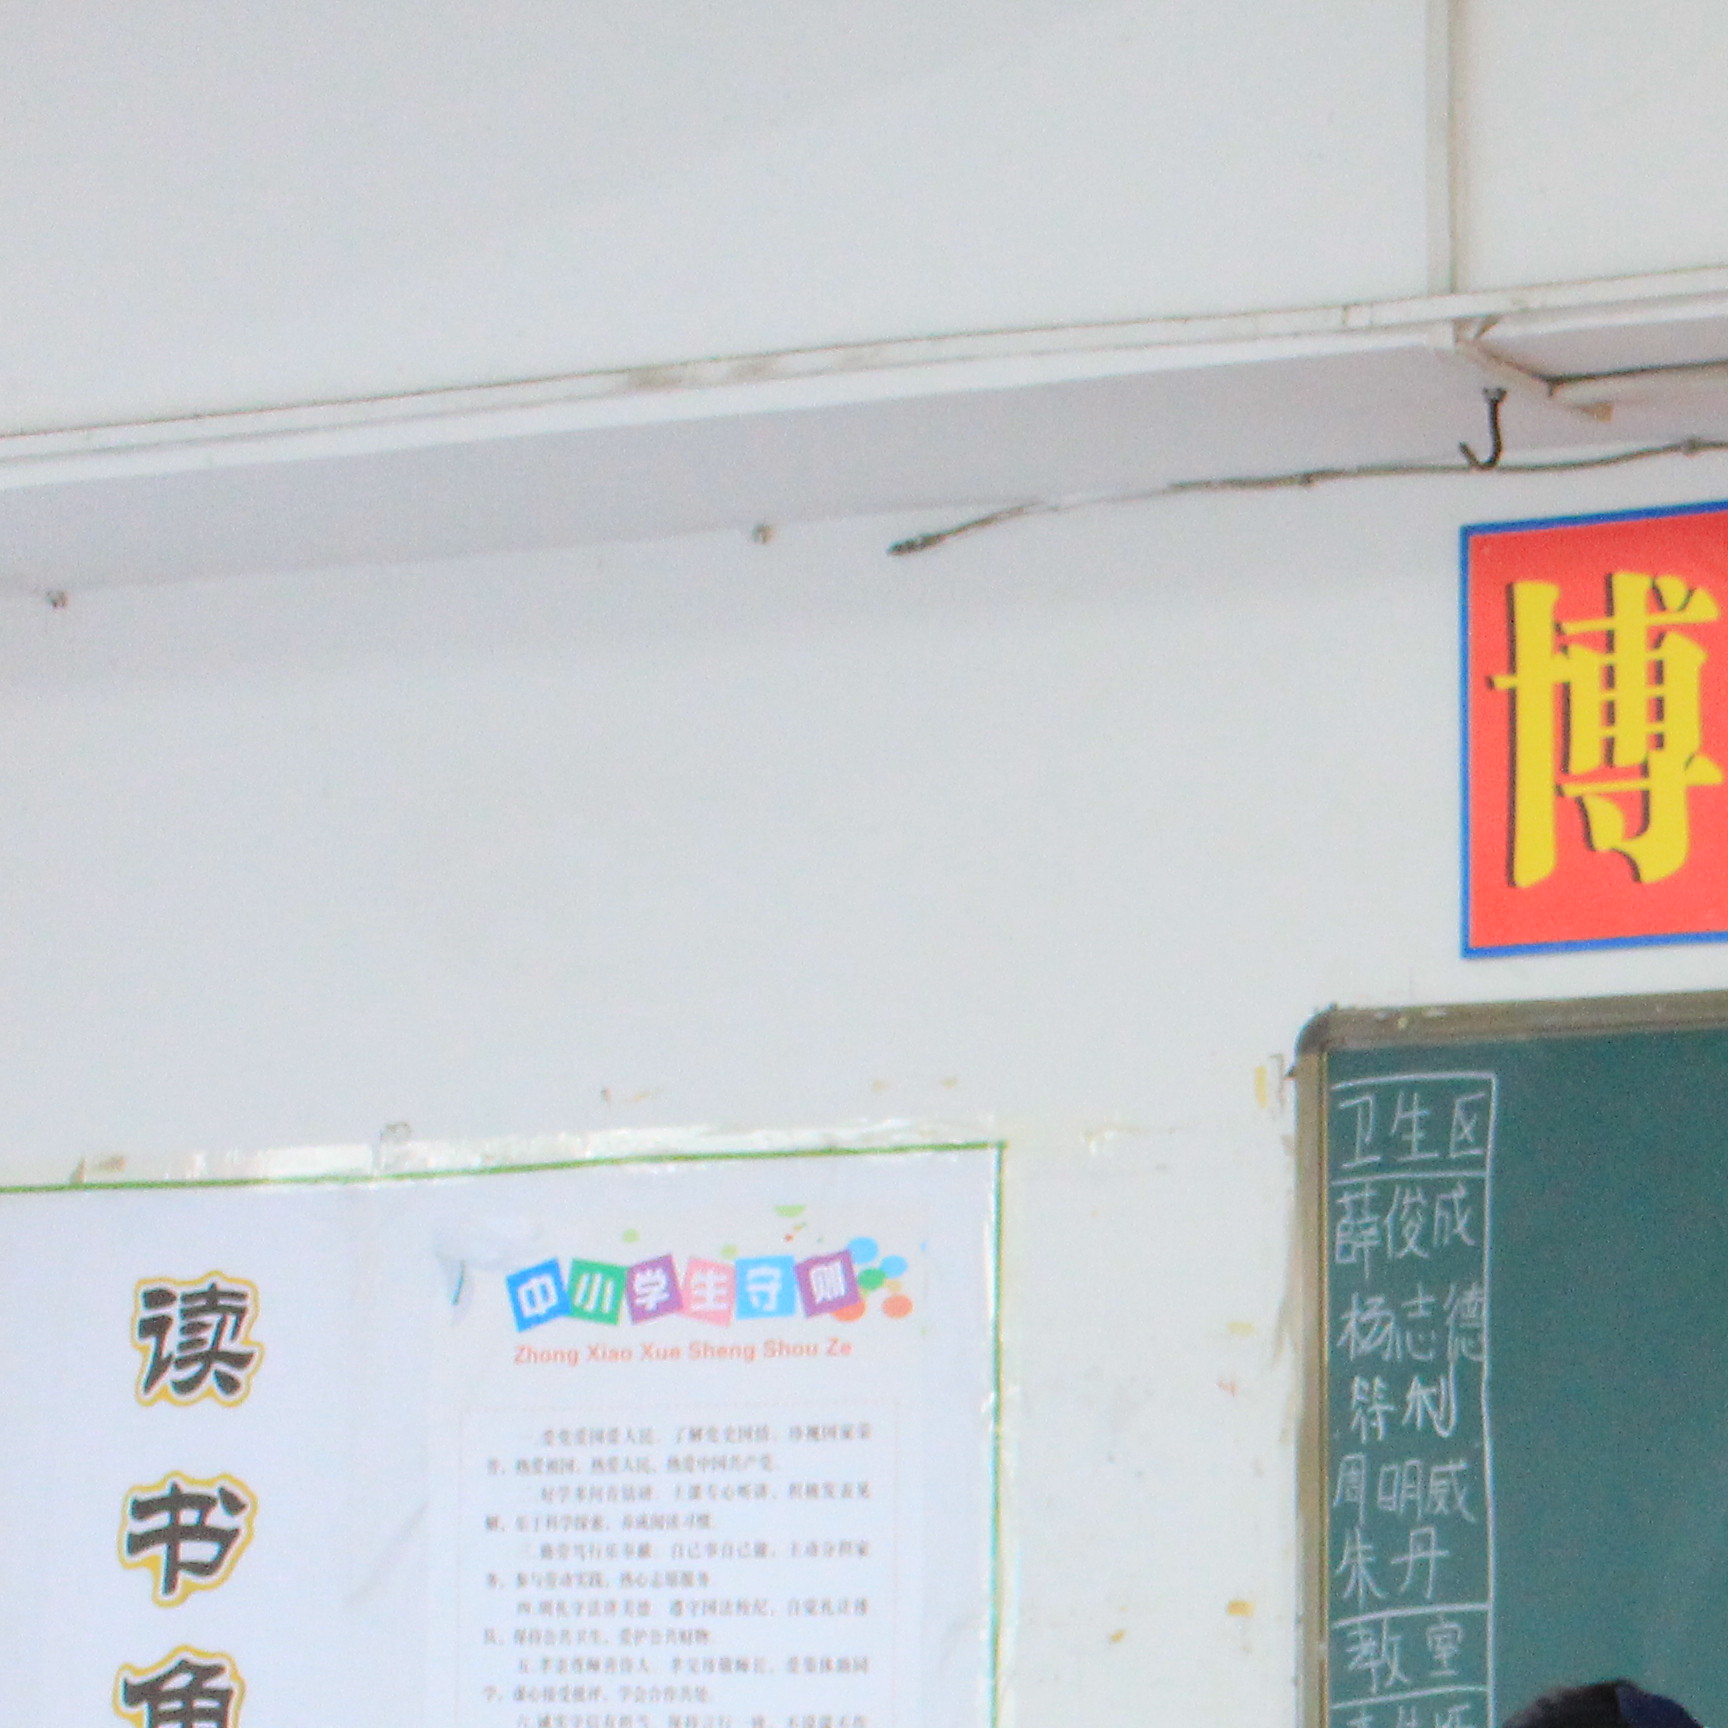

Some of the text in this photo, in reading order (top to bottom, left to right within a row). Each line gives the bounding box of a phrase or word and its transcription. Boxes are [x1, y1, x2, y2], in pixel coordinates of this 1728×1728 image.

[514, 1256, 850, 1324] 中小学生守则
[514, 1336, 853, 1366] Zhong Xiao Xue Sheng Shou Ze
